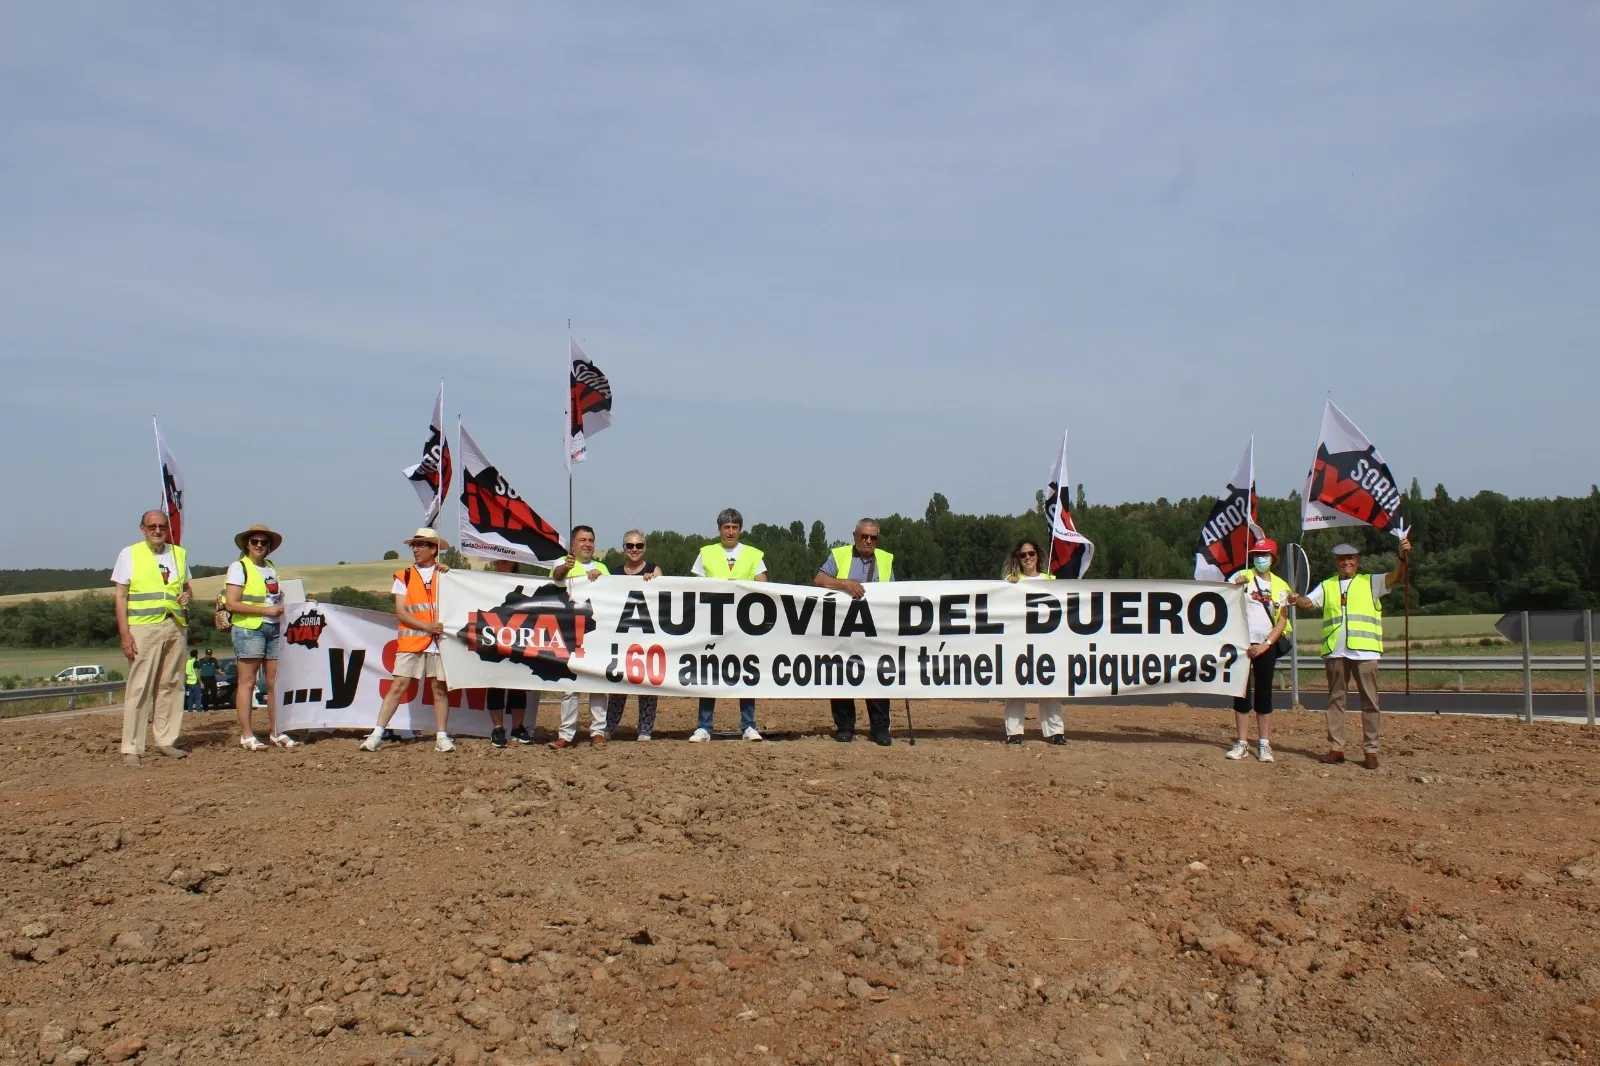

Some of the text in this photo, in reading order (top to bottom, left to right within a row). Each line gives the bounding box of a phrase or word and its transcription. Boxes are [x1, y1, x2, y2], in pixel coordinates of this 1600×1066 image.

[1350, 458, 1401, 517] SORIA
[300, 616, 321, 627] SORIA
[481, 626, 567, 649] SORIA
[615, 590, 1229, 638] AUTOVÍA DEL DUERO
[605, 641, 1239, 696] ¿60 años como el túnel de piqueras?
